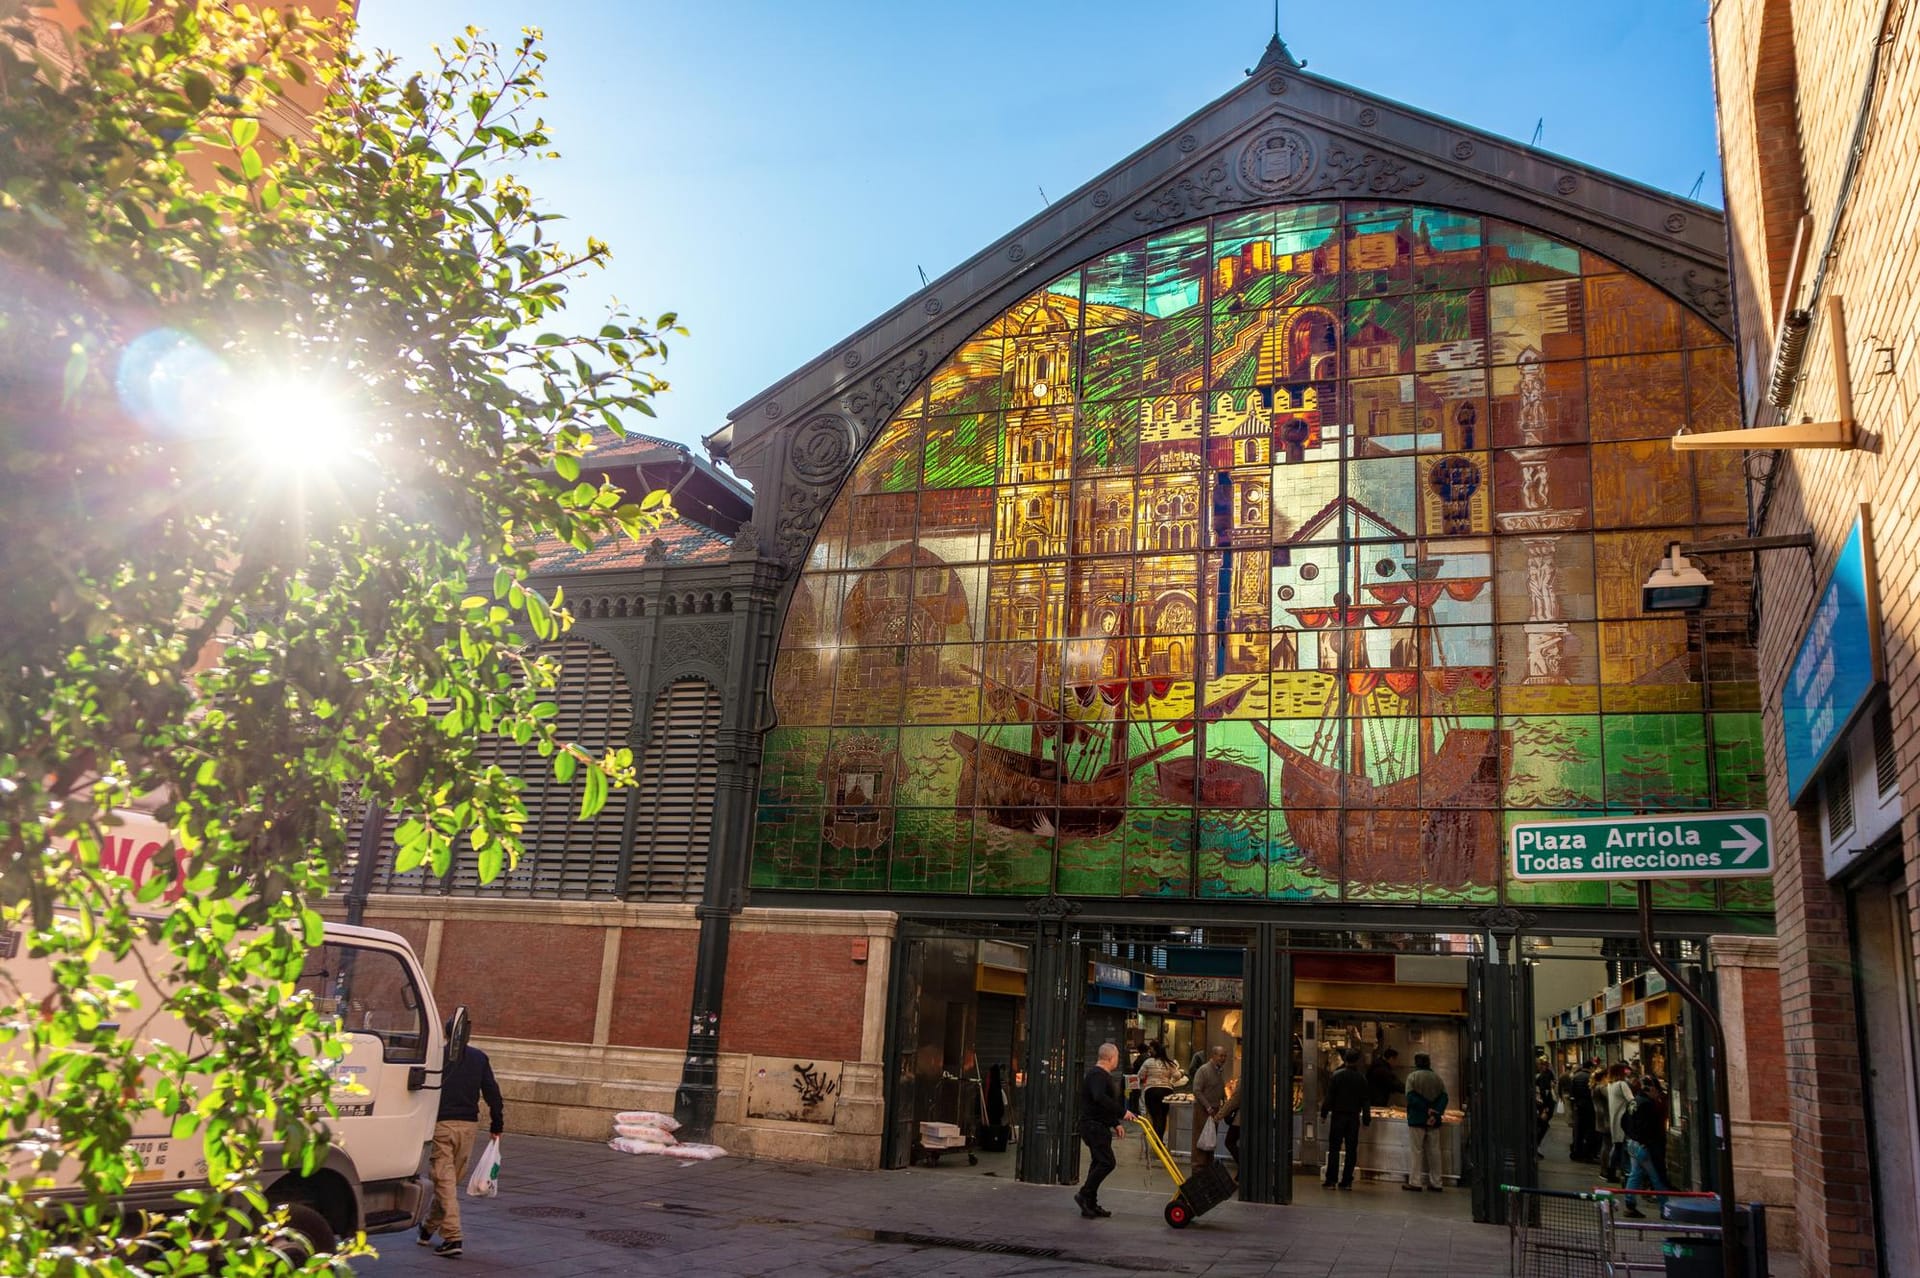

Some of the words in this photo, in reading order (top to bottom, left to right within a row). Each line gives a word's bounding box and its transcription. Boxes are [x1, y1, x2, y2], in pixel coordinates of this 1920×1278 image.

[1519, 831, 1587, 851] Plaza
[1606, 825, 1700, 848] Arriola
[1520, 854, 1584, 871] Todas
[1591, 850, 1722, 869] direcciones
